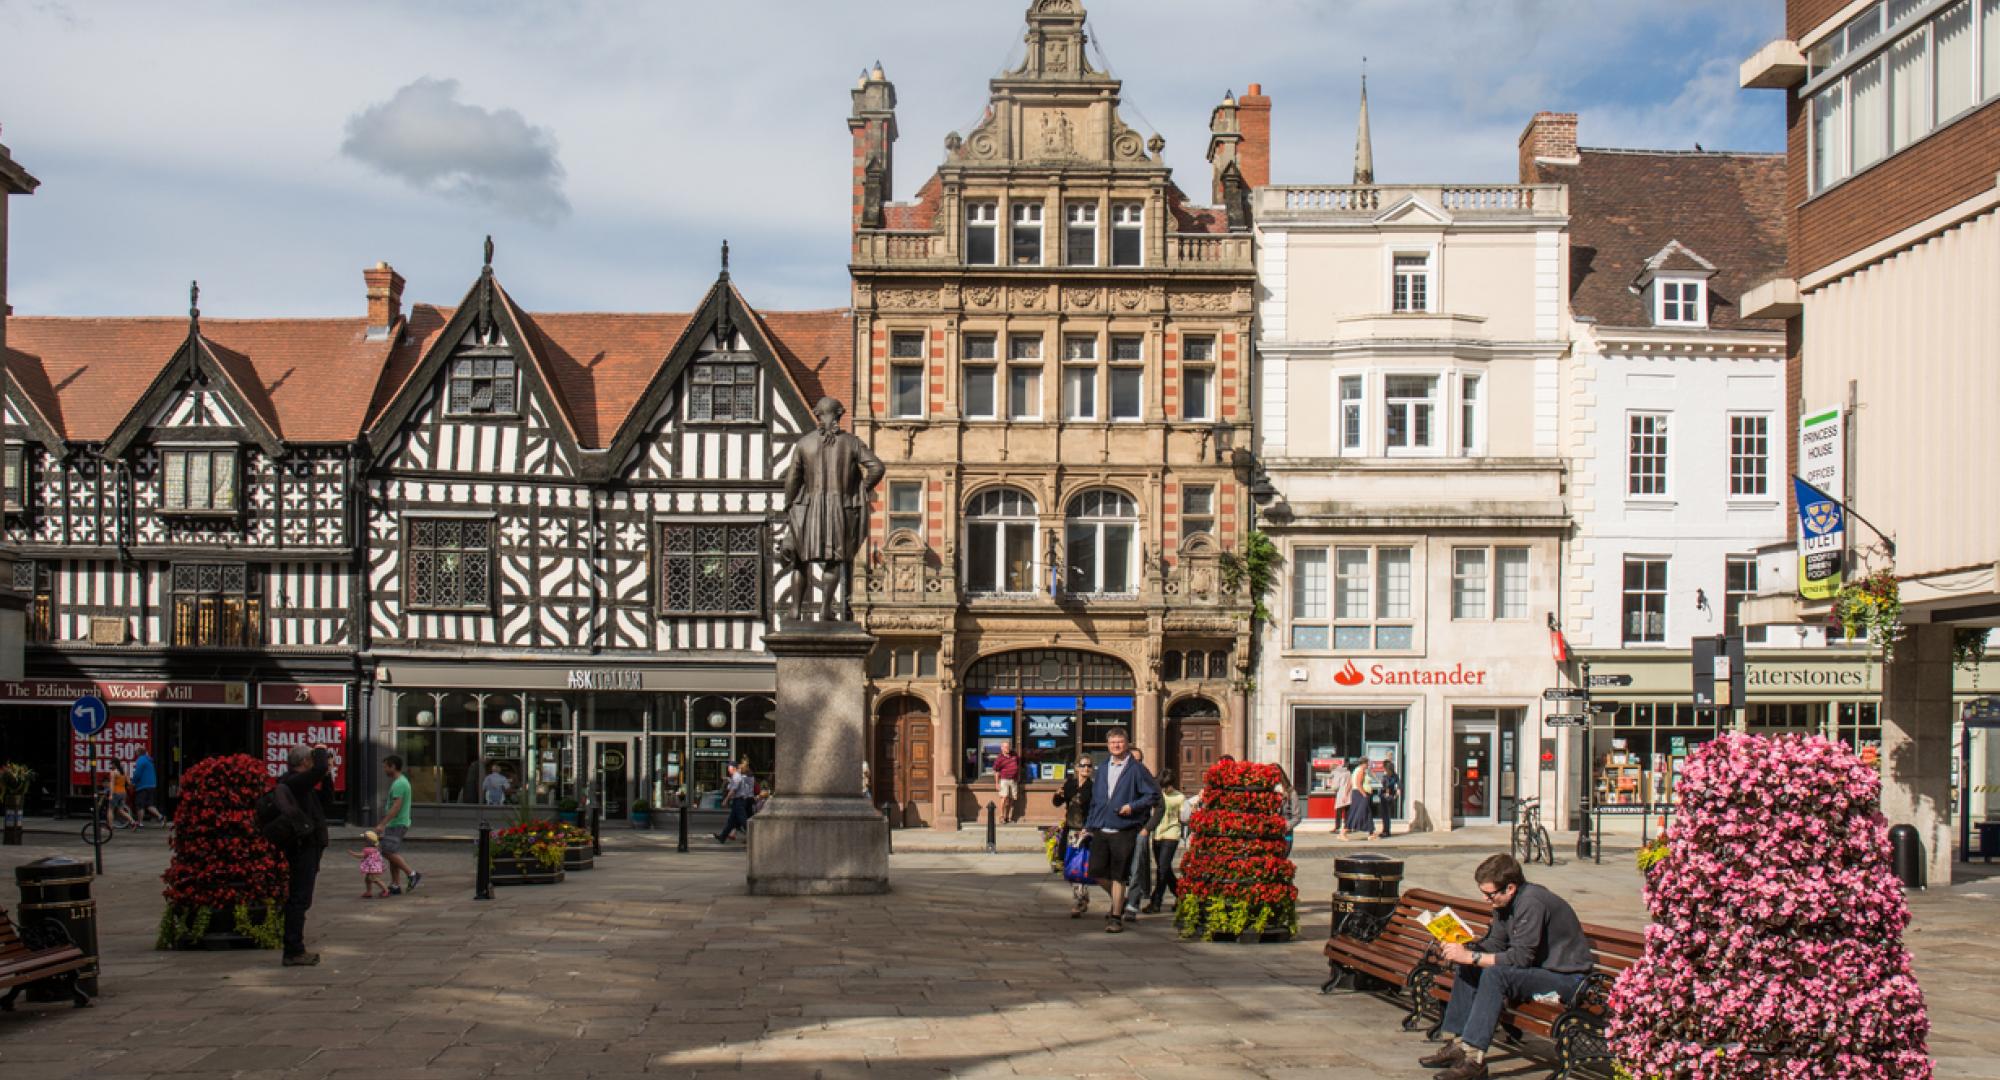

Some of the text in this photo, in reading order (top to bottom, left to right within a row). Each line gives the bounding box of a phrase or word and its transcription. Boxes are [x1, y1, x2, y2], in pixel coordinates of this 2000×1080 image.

[1803, 424, 1838, 446] PRINCESS
[1807, 443, 1833, 460] HOUSE
[1807, 465, 1835, 482] OFFICES
[568, 669, 592, 690] ASK
[1370, 662, 1487, 686] Santander
[1745, 664, 1863, 686] aterstones
[6, 684, 193, 700] The Edinburgh Woollen Mill
[295, 687, 309, 702] 25
[74, 728, 113, 742] SLE
[114, 721, 149, 739] SALE
[308, 726, 342, 744] SALE
[267, 732, 307, 746] SALE
